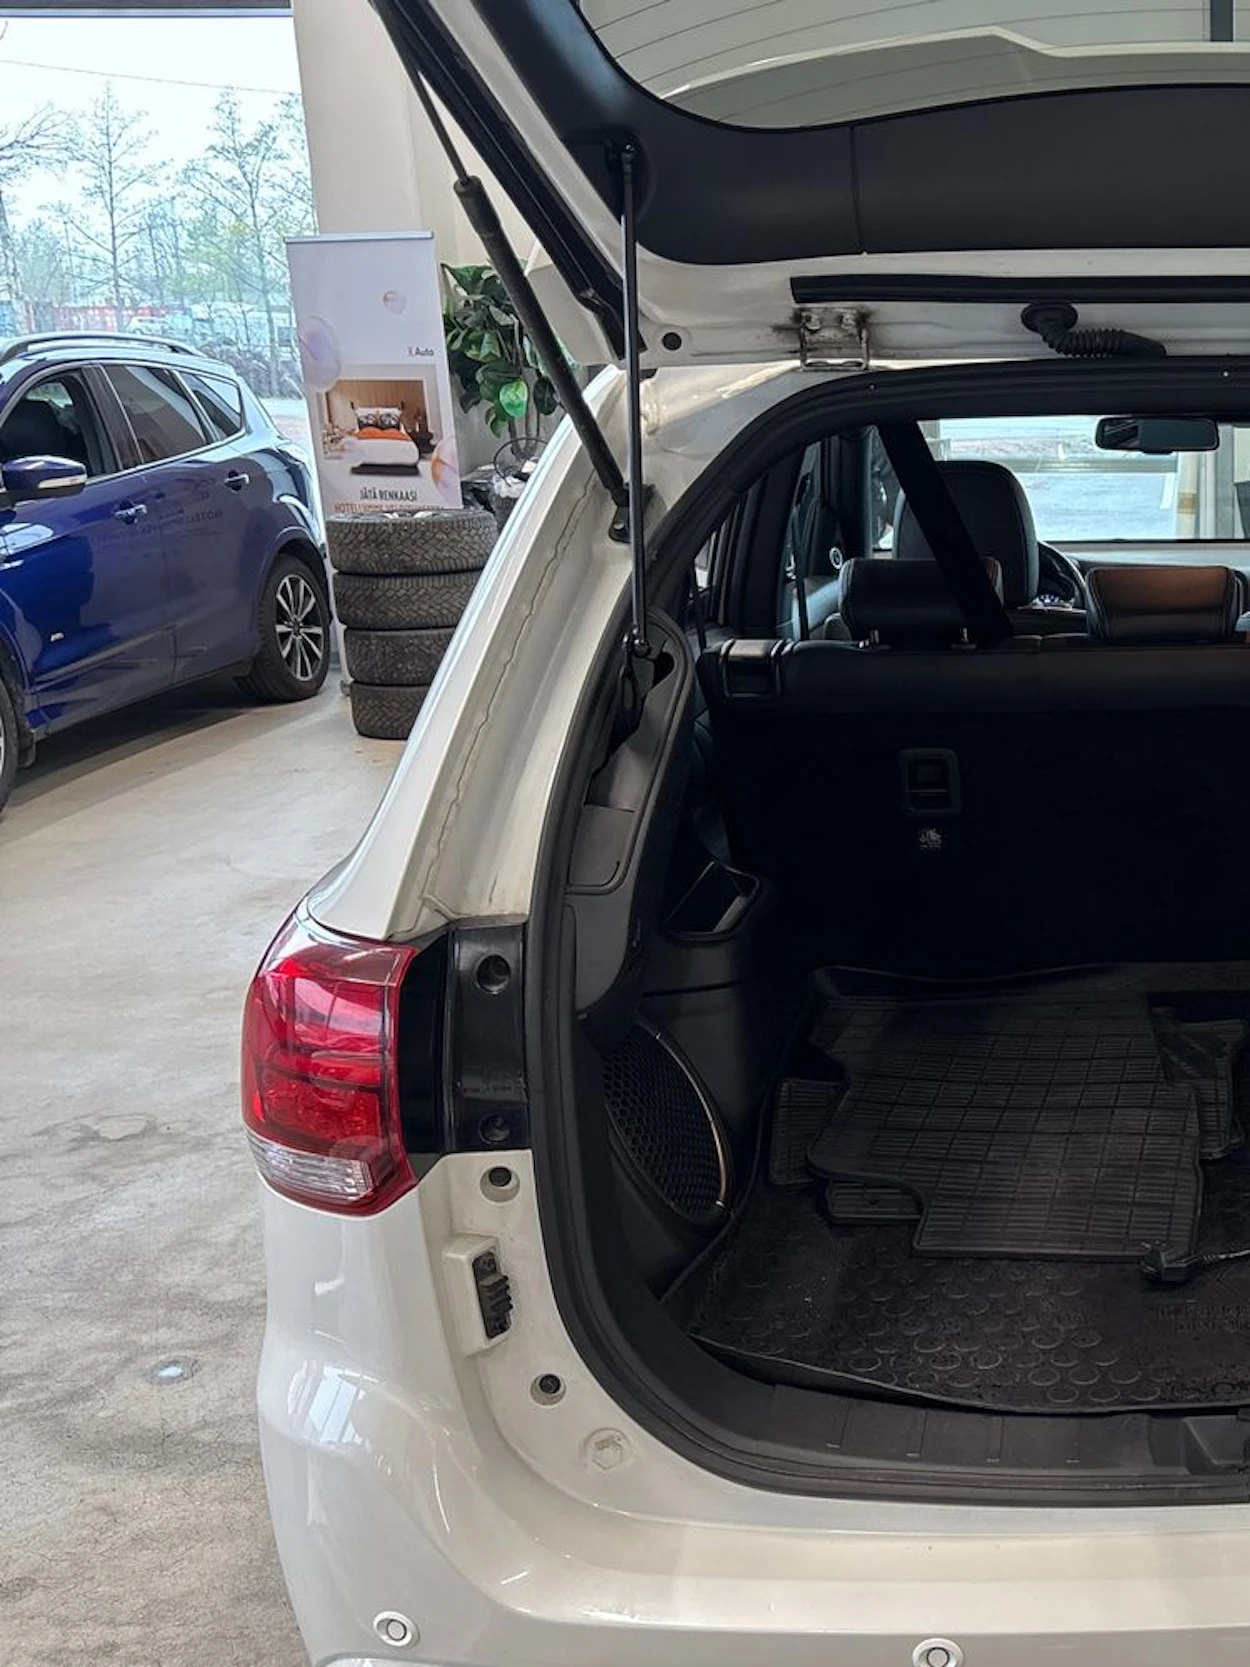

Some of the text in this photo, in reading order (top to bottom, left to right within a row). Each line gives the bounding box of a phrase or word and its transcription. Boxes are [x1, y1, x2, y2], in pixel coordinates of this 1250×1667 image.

[415, 346, 434, 357] Auto
[360, 486, 418, 502] JÄTÄ RENKAASI
